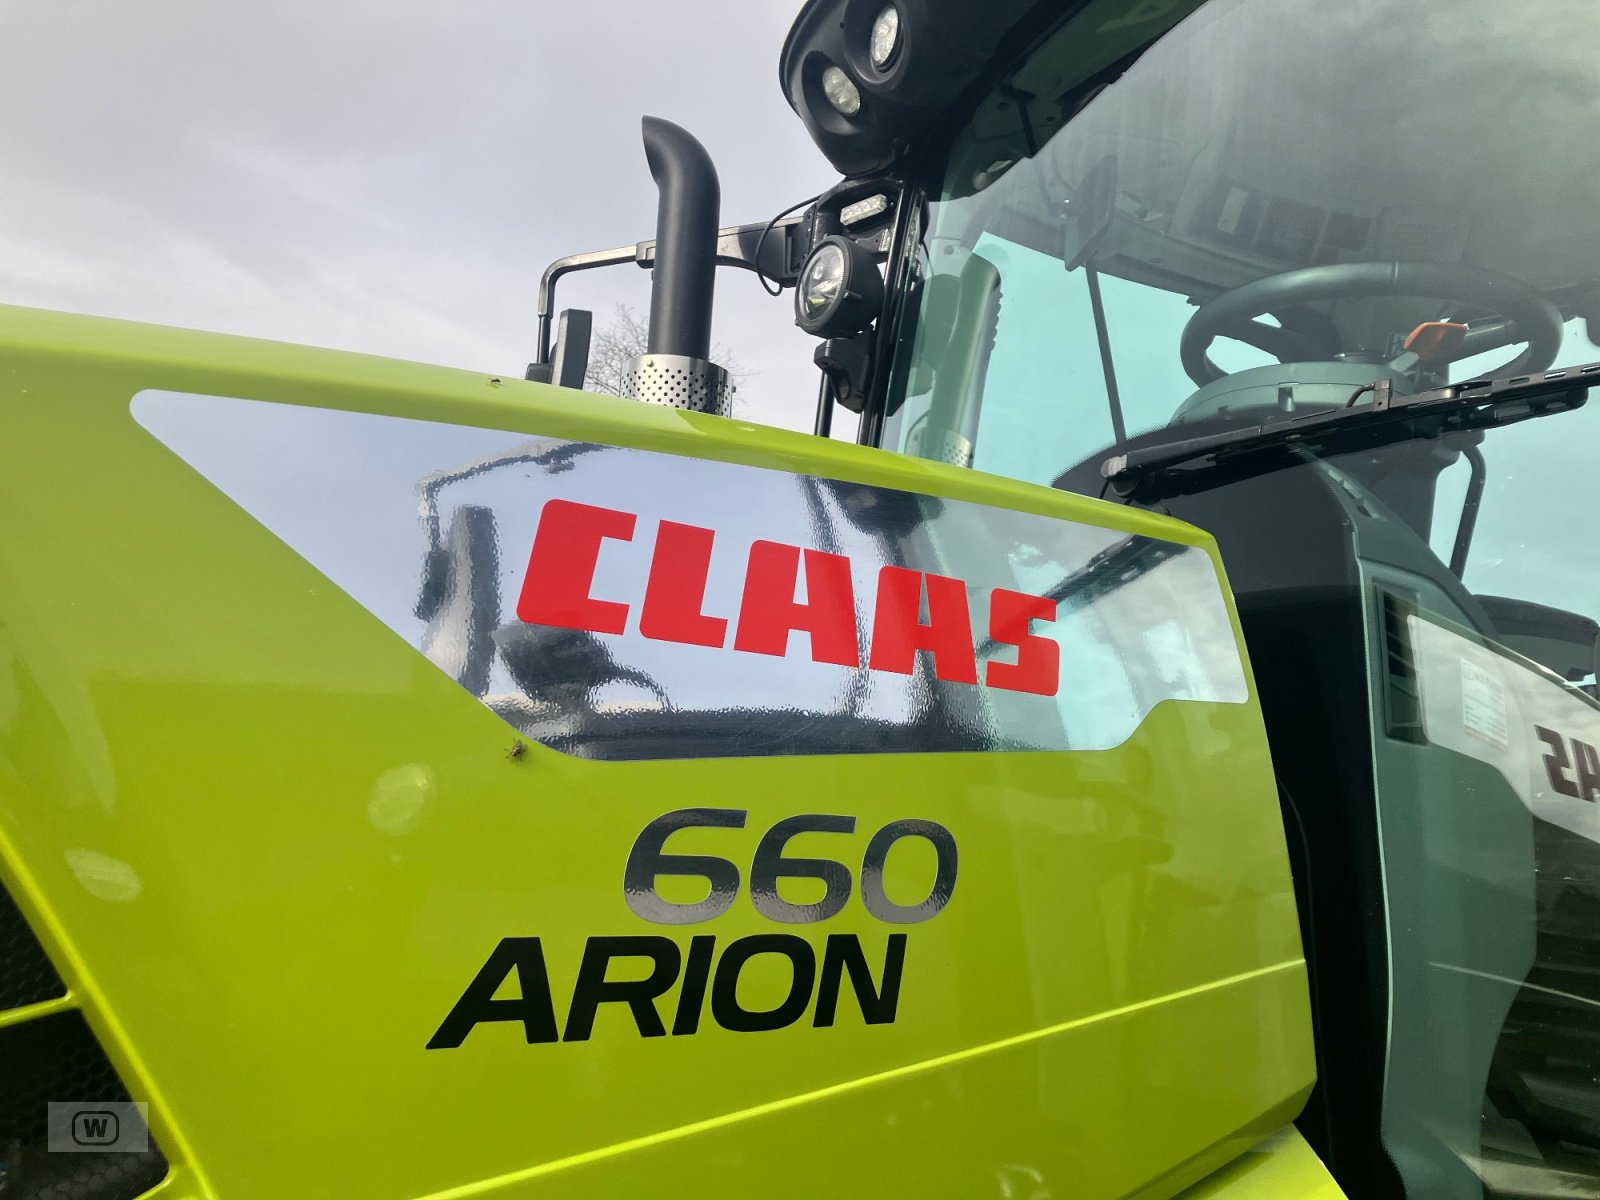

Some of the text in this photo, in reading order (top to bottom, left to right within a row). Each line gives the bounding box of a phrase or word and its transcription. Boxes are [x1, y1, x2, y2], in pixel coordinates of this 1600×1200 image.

[516, 499, 1060, 697] CLAAS
[623, 807, 959, 926] 660
[425, 933, 908, 1050] ARION
